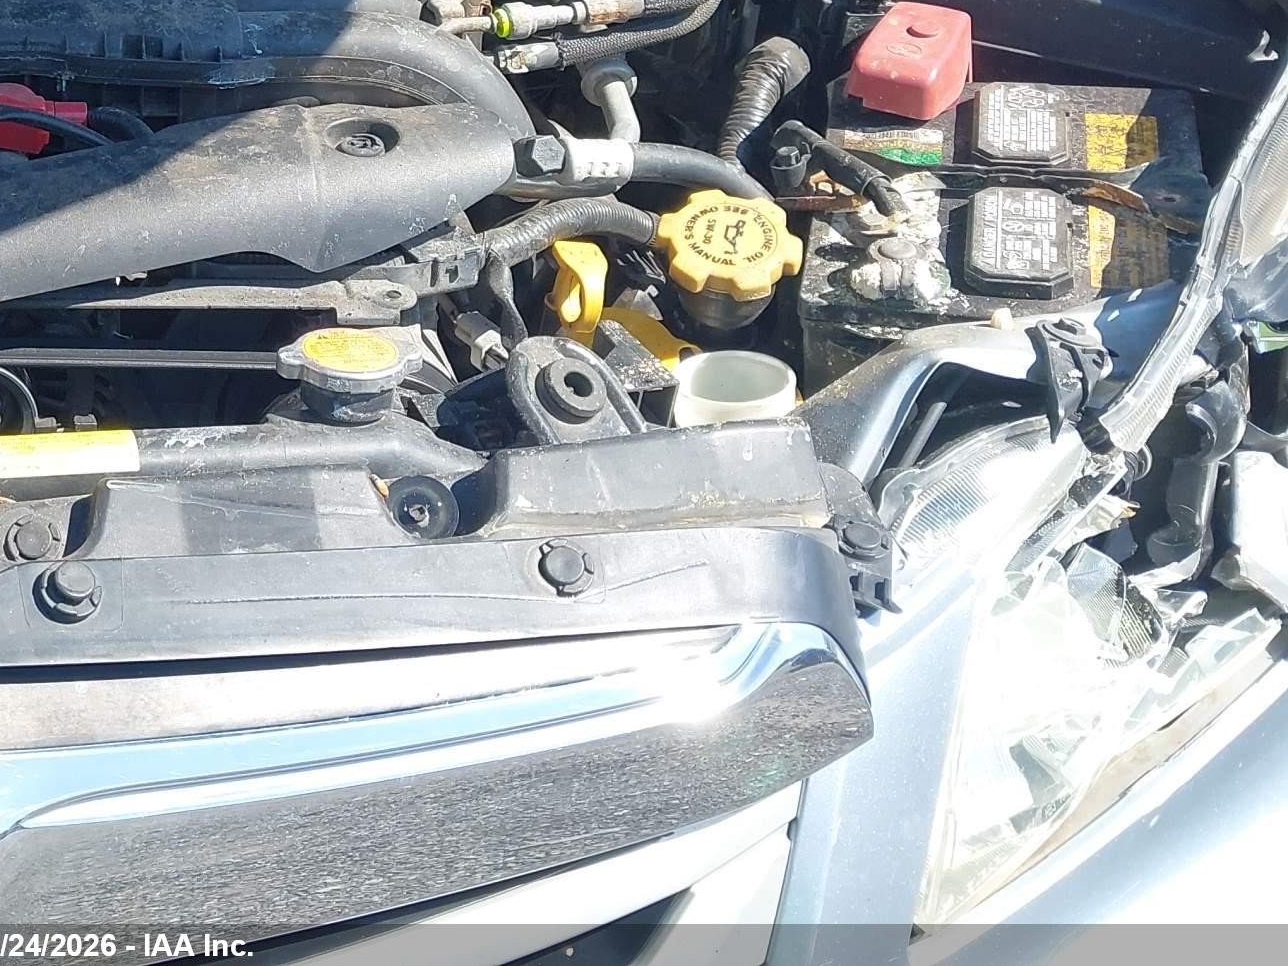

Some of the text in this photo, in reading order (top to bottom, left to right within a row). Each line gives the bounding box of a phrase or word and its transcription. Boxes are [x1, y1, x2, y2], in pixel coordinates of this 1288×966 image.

[723, 205, 750, 215] SEE
[701, 218, 716, 245] 5W-30
[742, 214, 774, 263] ENGINE OIL
[688, 241, 737, 266] MANUAL
